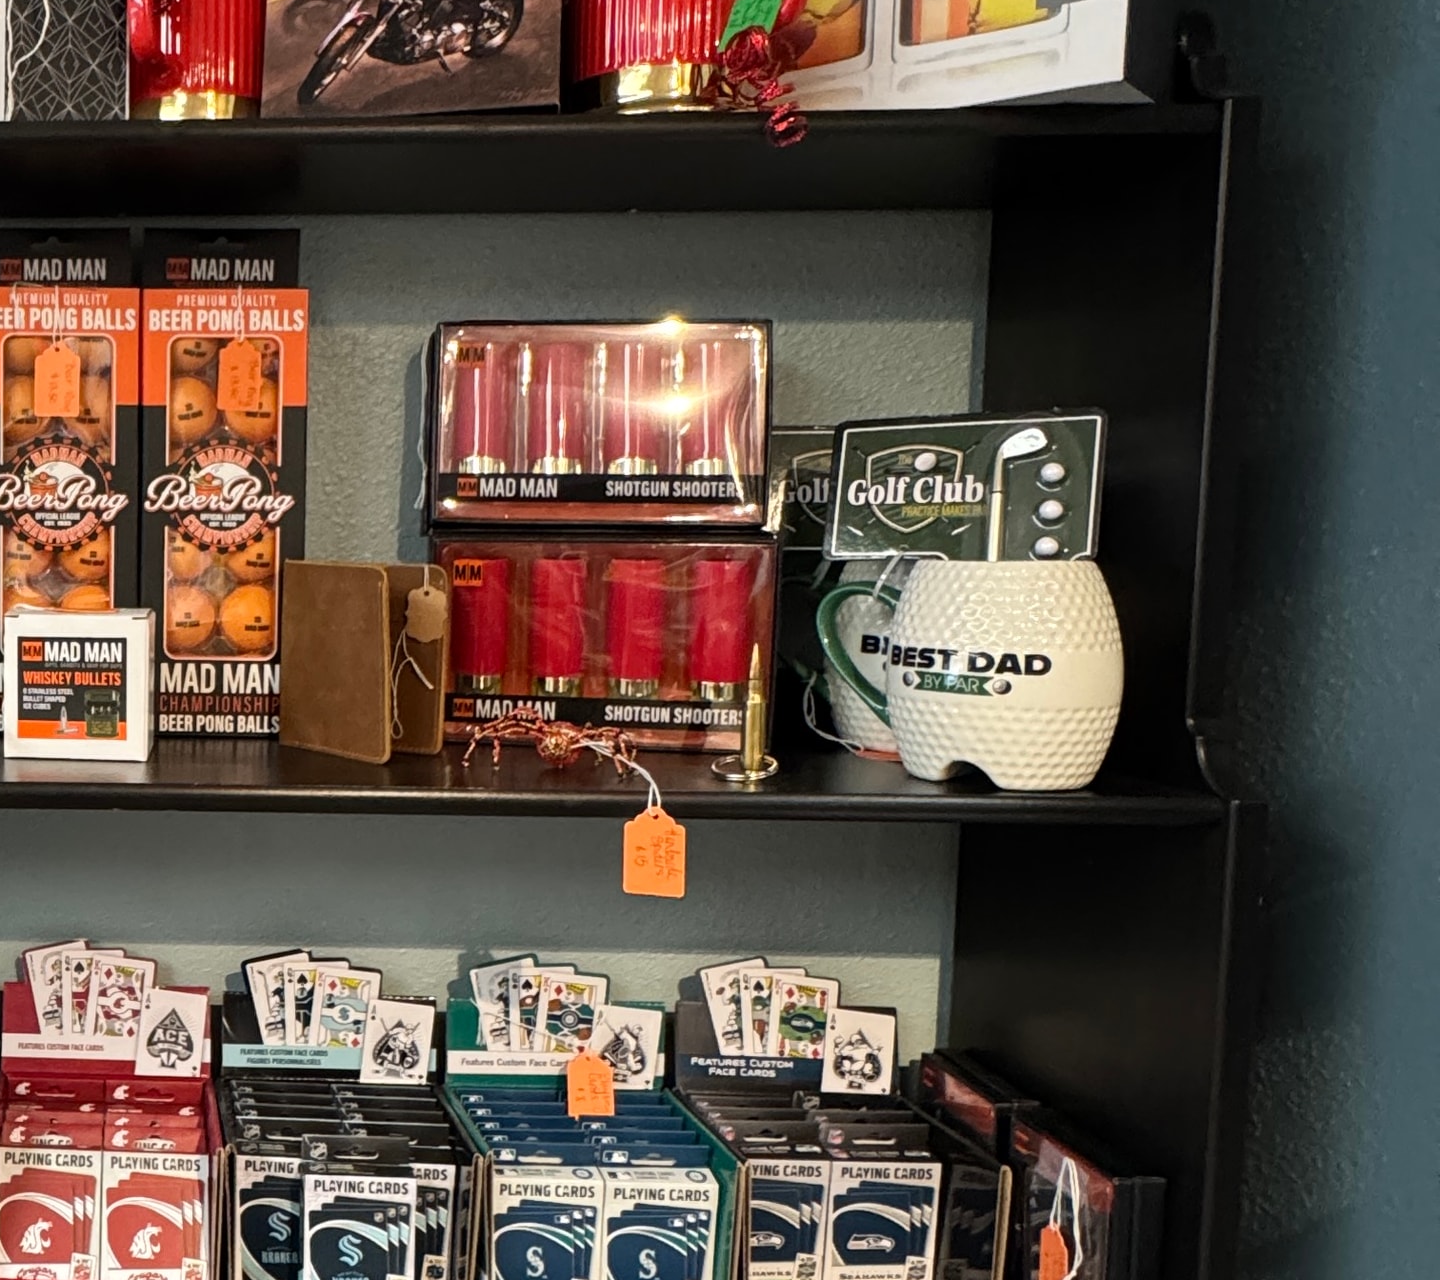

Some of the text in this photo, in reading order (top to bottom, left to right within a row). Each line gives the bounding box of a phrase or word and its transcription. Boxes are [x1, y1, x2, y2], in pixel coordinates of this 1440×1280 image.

[24, 258, 107, 281] MAD MAN
[190, 258, 275, 282] MAD MAN
[63, 293, 108, 306] QUALITY
[177, 294, 276, 307] PREMIUM QUALITY
[29, 307, 78, 330] PONG
[81, 308, 137, 331] BALLS
[149, 309, 305, 332] BEER PONG BALLS
[480, 477, 744, 498] MAD MAN SHOTGUN SHOOTERS
[847, 474, 984, 506] Golf Club
[56, 474, 129, 523] Pong
[144, 473, 296, 524] Beer Pong
[901, 505, 940, 517] PRACTICE
[44, 641, 123, 663] MAD MAN
[890, 644, 1052, 676] BEST DAD
[22, 671, 122, 686] WHISKEY BULLETS
[160, 662, 281, 695] MAD MAN
[923, 674, 980, 693] BY PAR
[160, 695, 280, 714] CHAMPIONSHIP
[475, 699, 670, 722] MAD MAN SHOTGUN
[160, 714, 280, 734] BEER PONG BALLS
[153, 1029, 189, 1047] ACE
[461, 1057, 548, 1067] Features Custom Face
[708, 1067, 777, 1078] FACE CARDS
[4, 1151, 94, 1168] PLAYING CARDS
[244, 1159, 294, 1174] PLAYING
[783, 1165, 822, 1178] CARDS
[841, 1167, 933, 1181] PLAYING CARDS
[313, 1179, 409, 1195] PLAYING CARDS
[499, 1184, 595, 1199] PLAYING CARDS
[613, 1188, 710, 1202] PLAYING CARDS
[839, 1272, 902, 1280] SEAHAWKS
